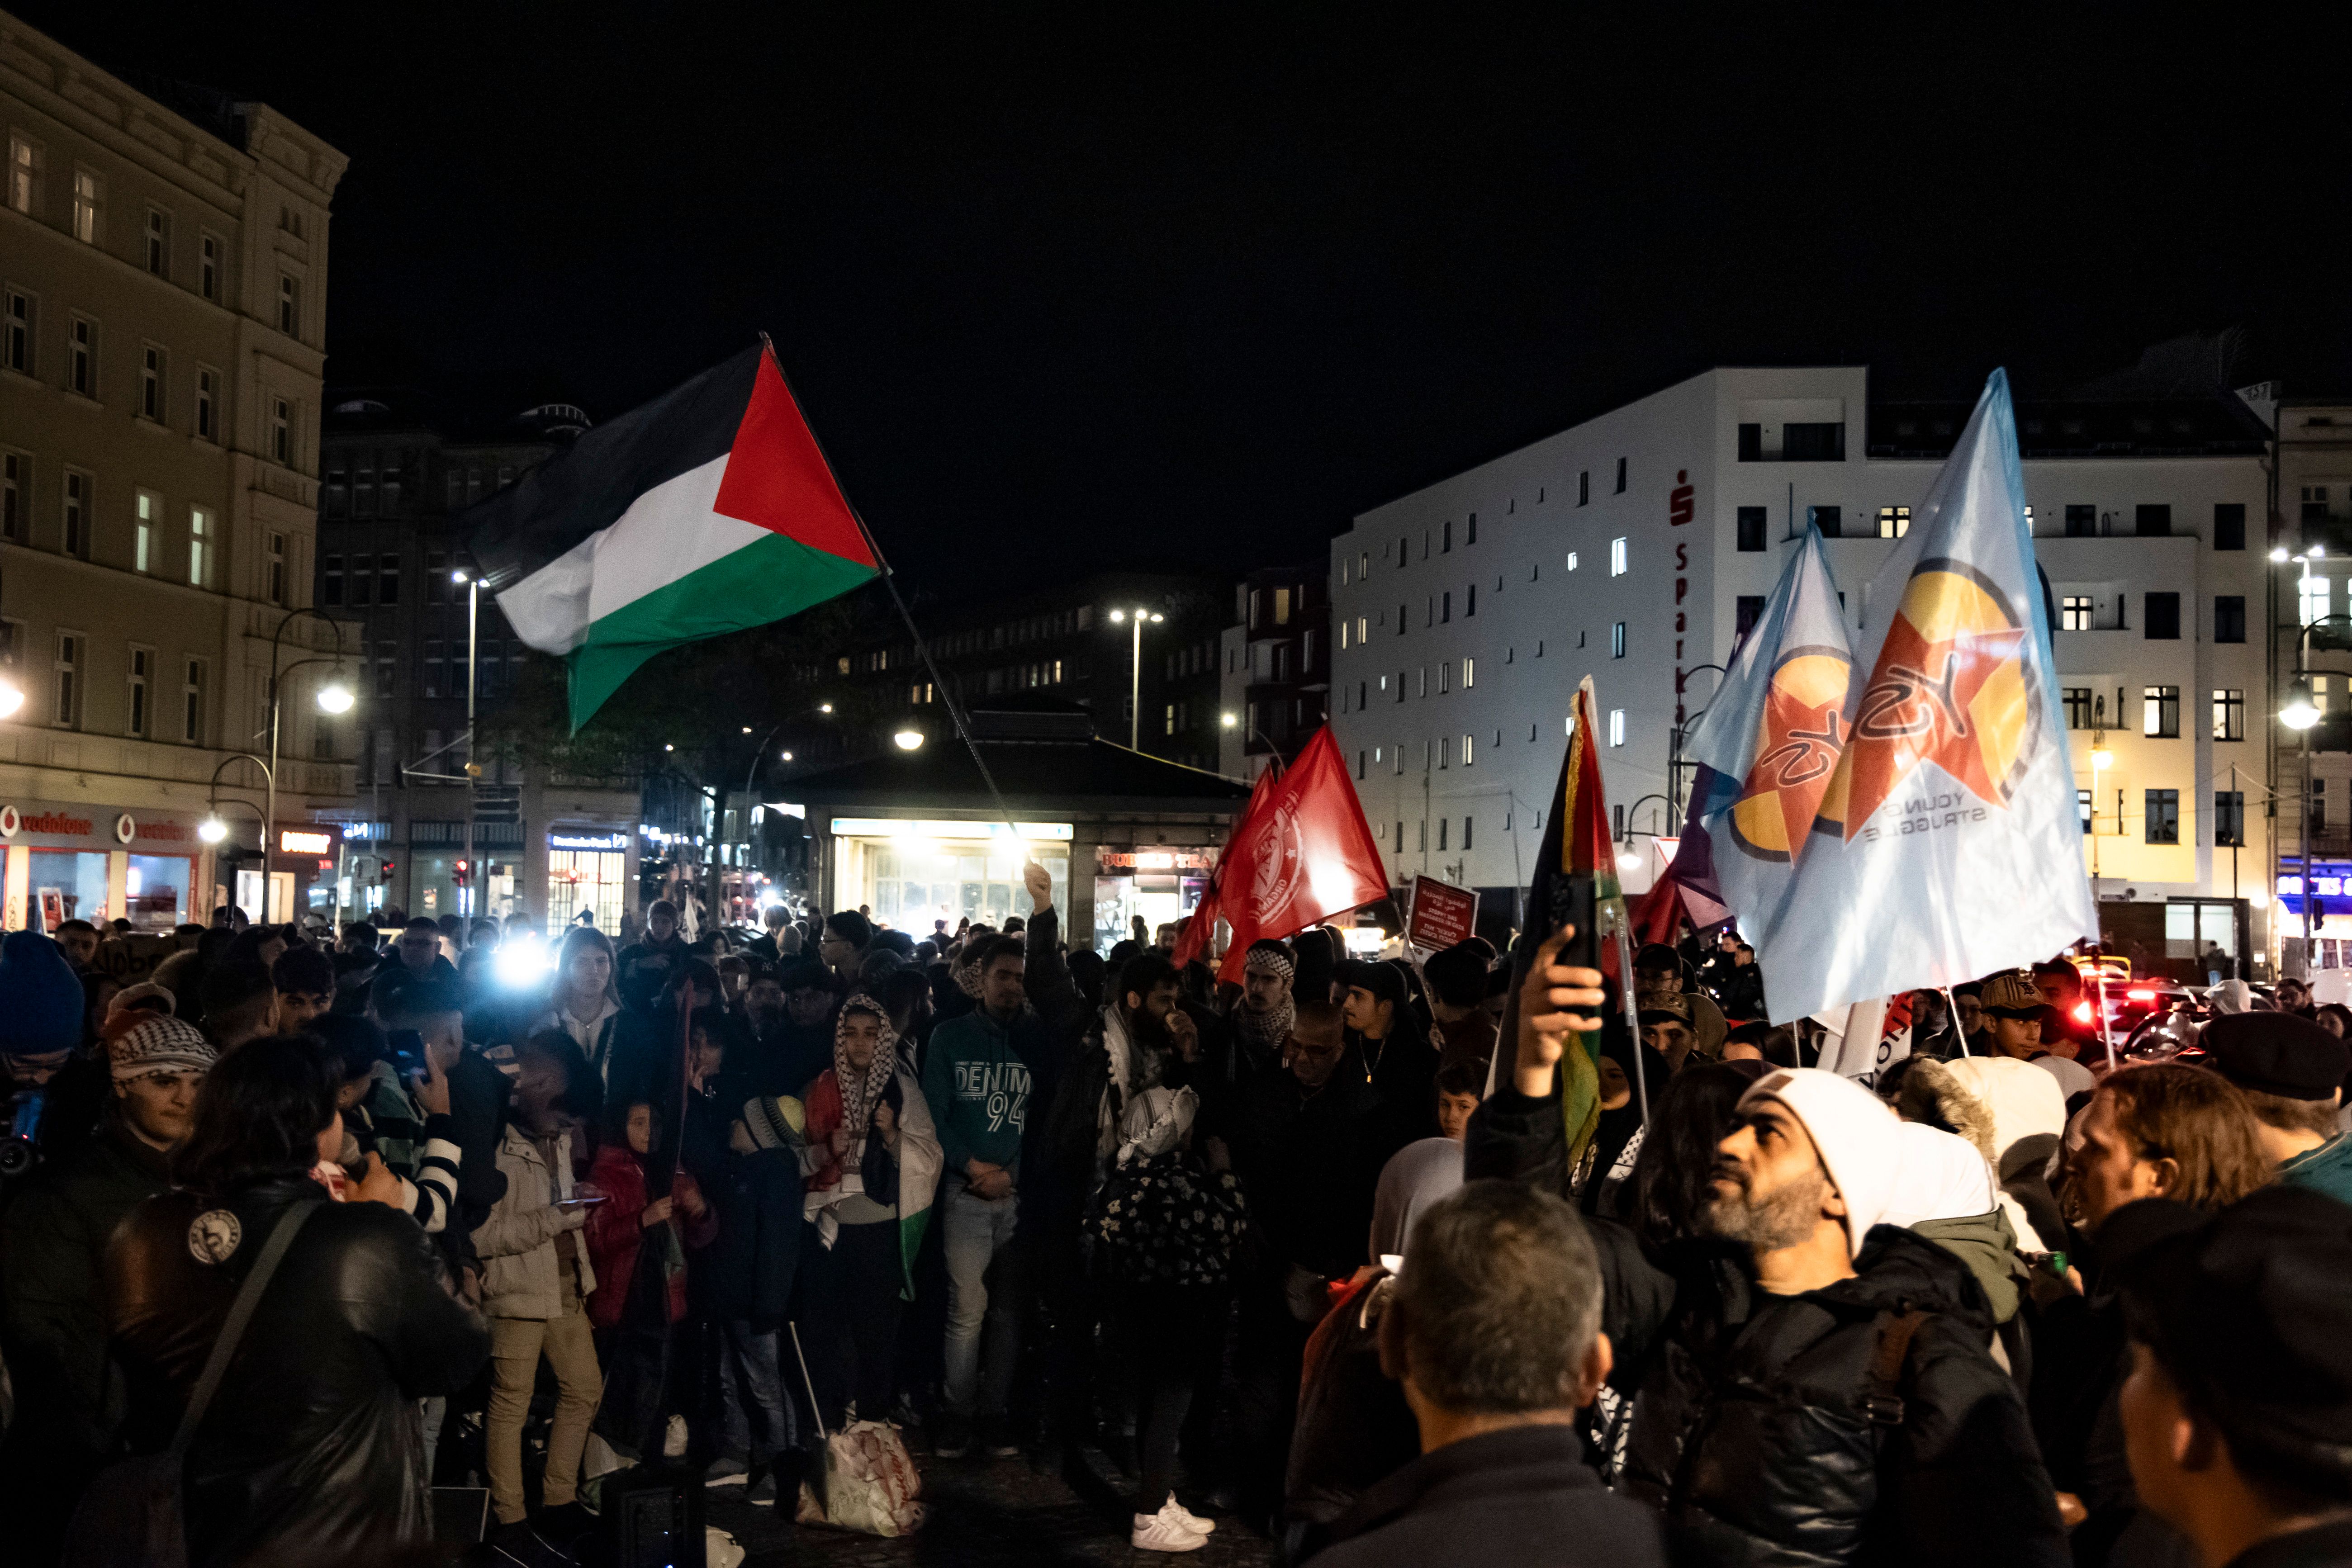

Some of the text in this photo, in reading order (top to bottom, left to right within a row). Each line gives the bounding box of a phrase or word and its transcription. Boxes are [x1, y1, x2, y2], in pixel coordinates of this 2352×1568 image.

[1175, 853, 1212, 868] TEA
[2278, 876, 2343, 895] DRKS
[955, 1063, 1031, 1095] DENIM
[987, 1091, 1025, 1136] 94
